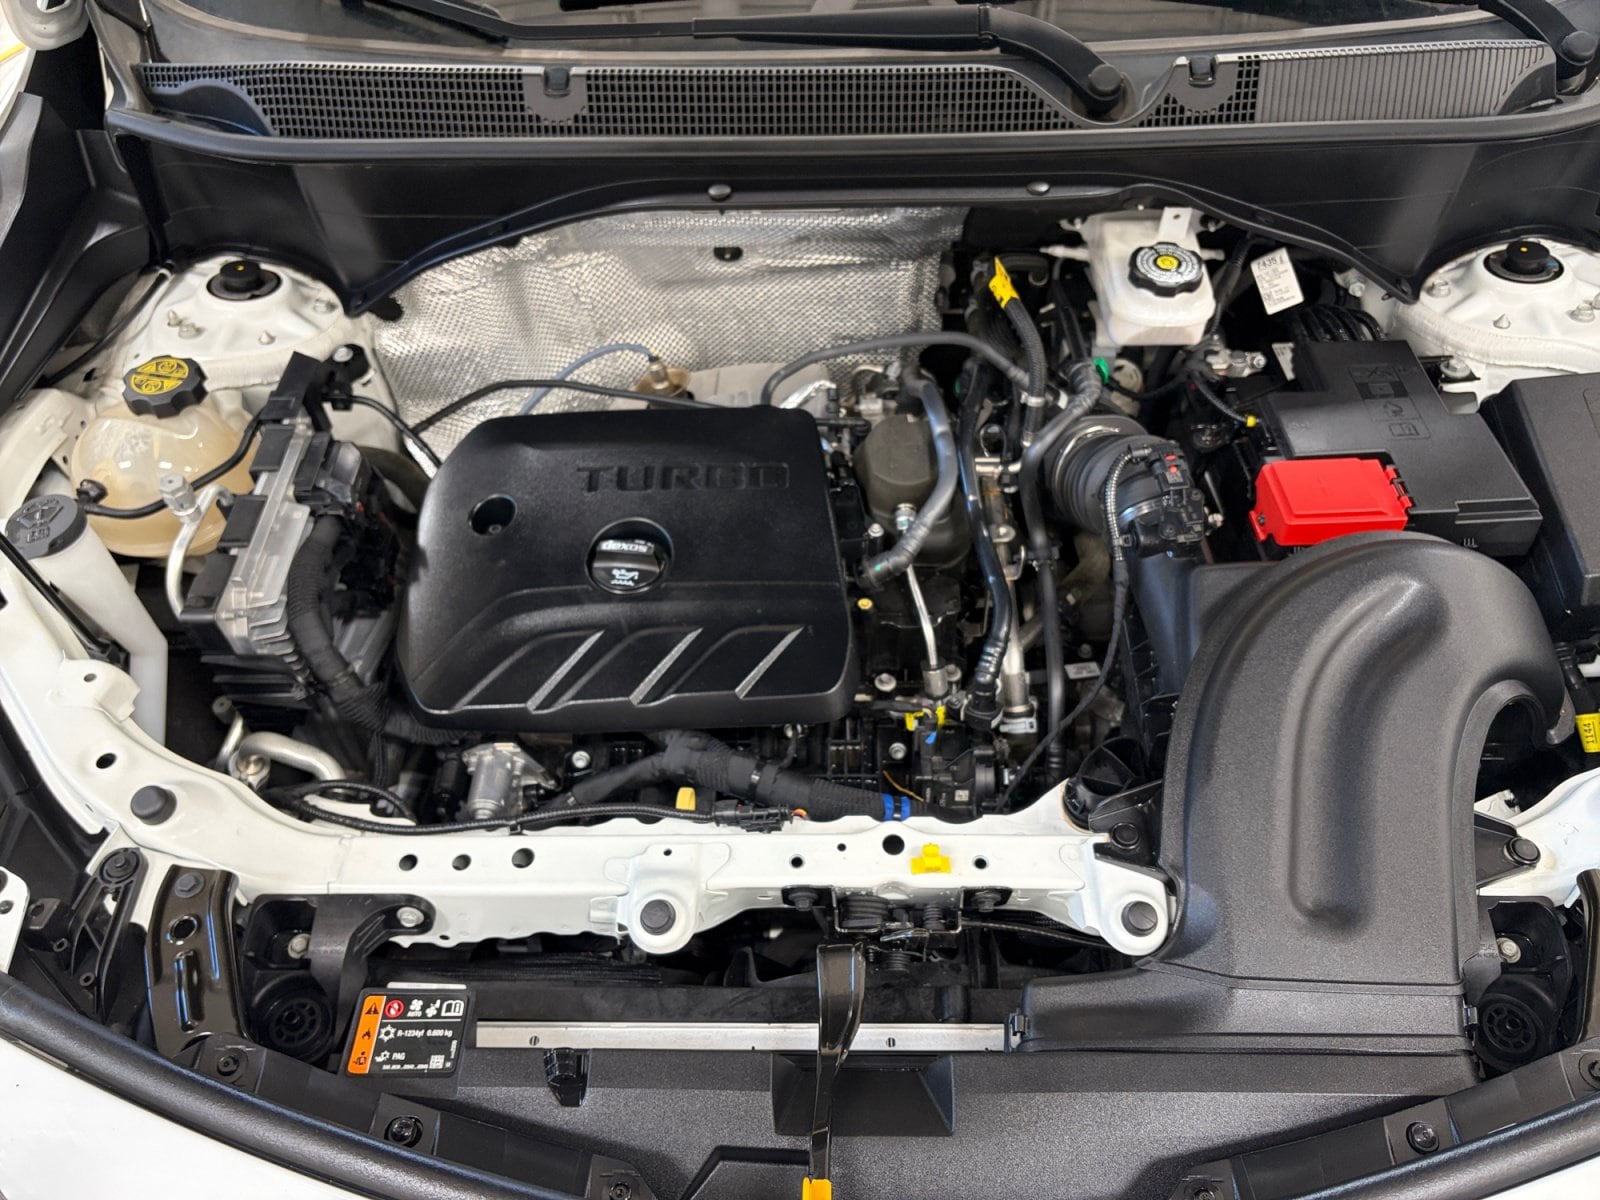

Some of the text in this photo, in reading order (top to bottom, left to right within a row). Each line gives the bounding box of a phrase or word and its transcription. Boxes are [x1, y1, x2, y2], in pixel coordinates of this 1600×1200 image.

[577, 461, 790, 493] TURBO
[601, 540, 648, 552] dexos
[444, 1029, 453, 1038] kg
